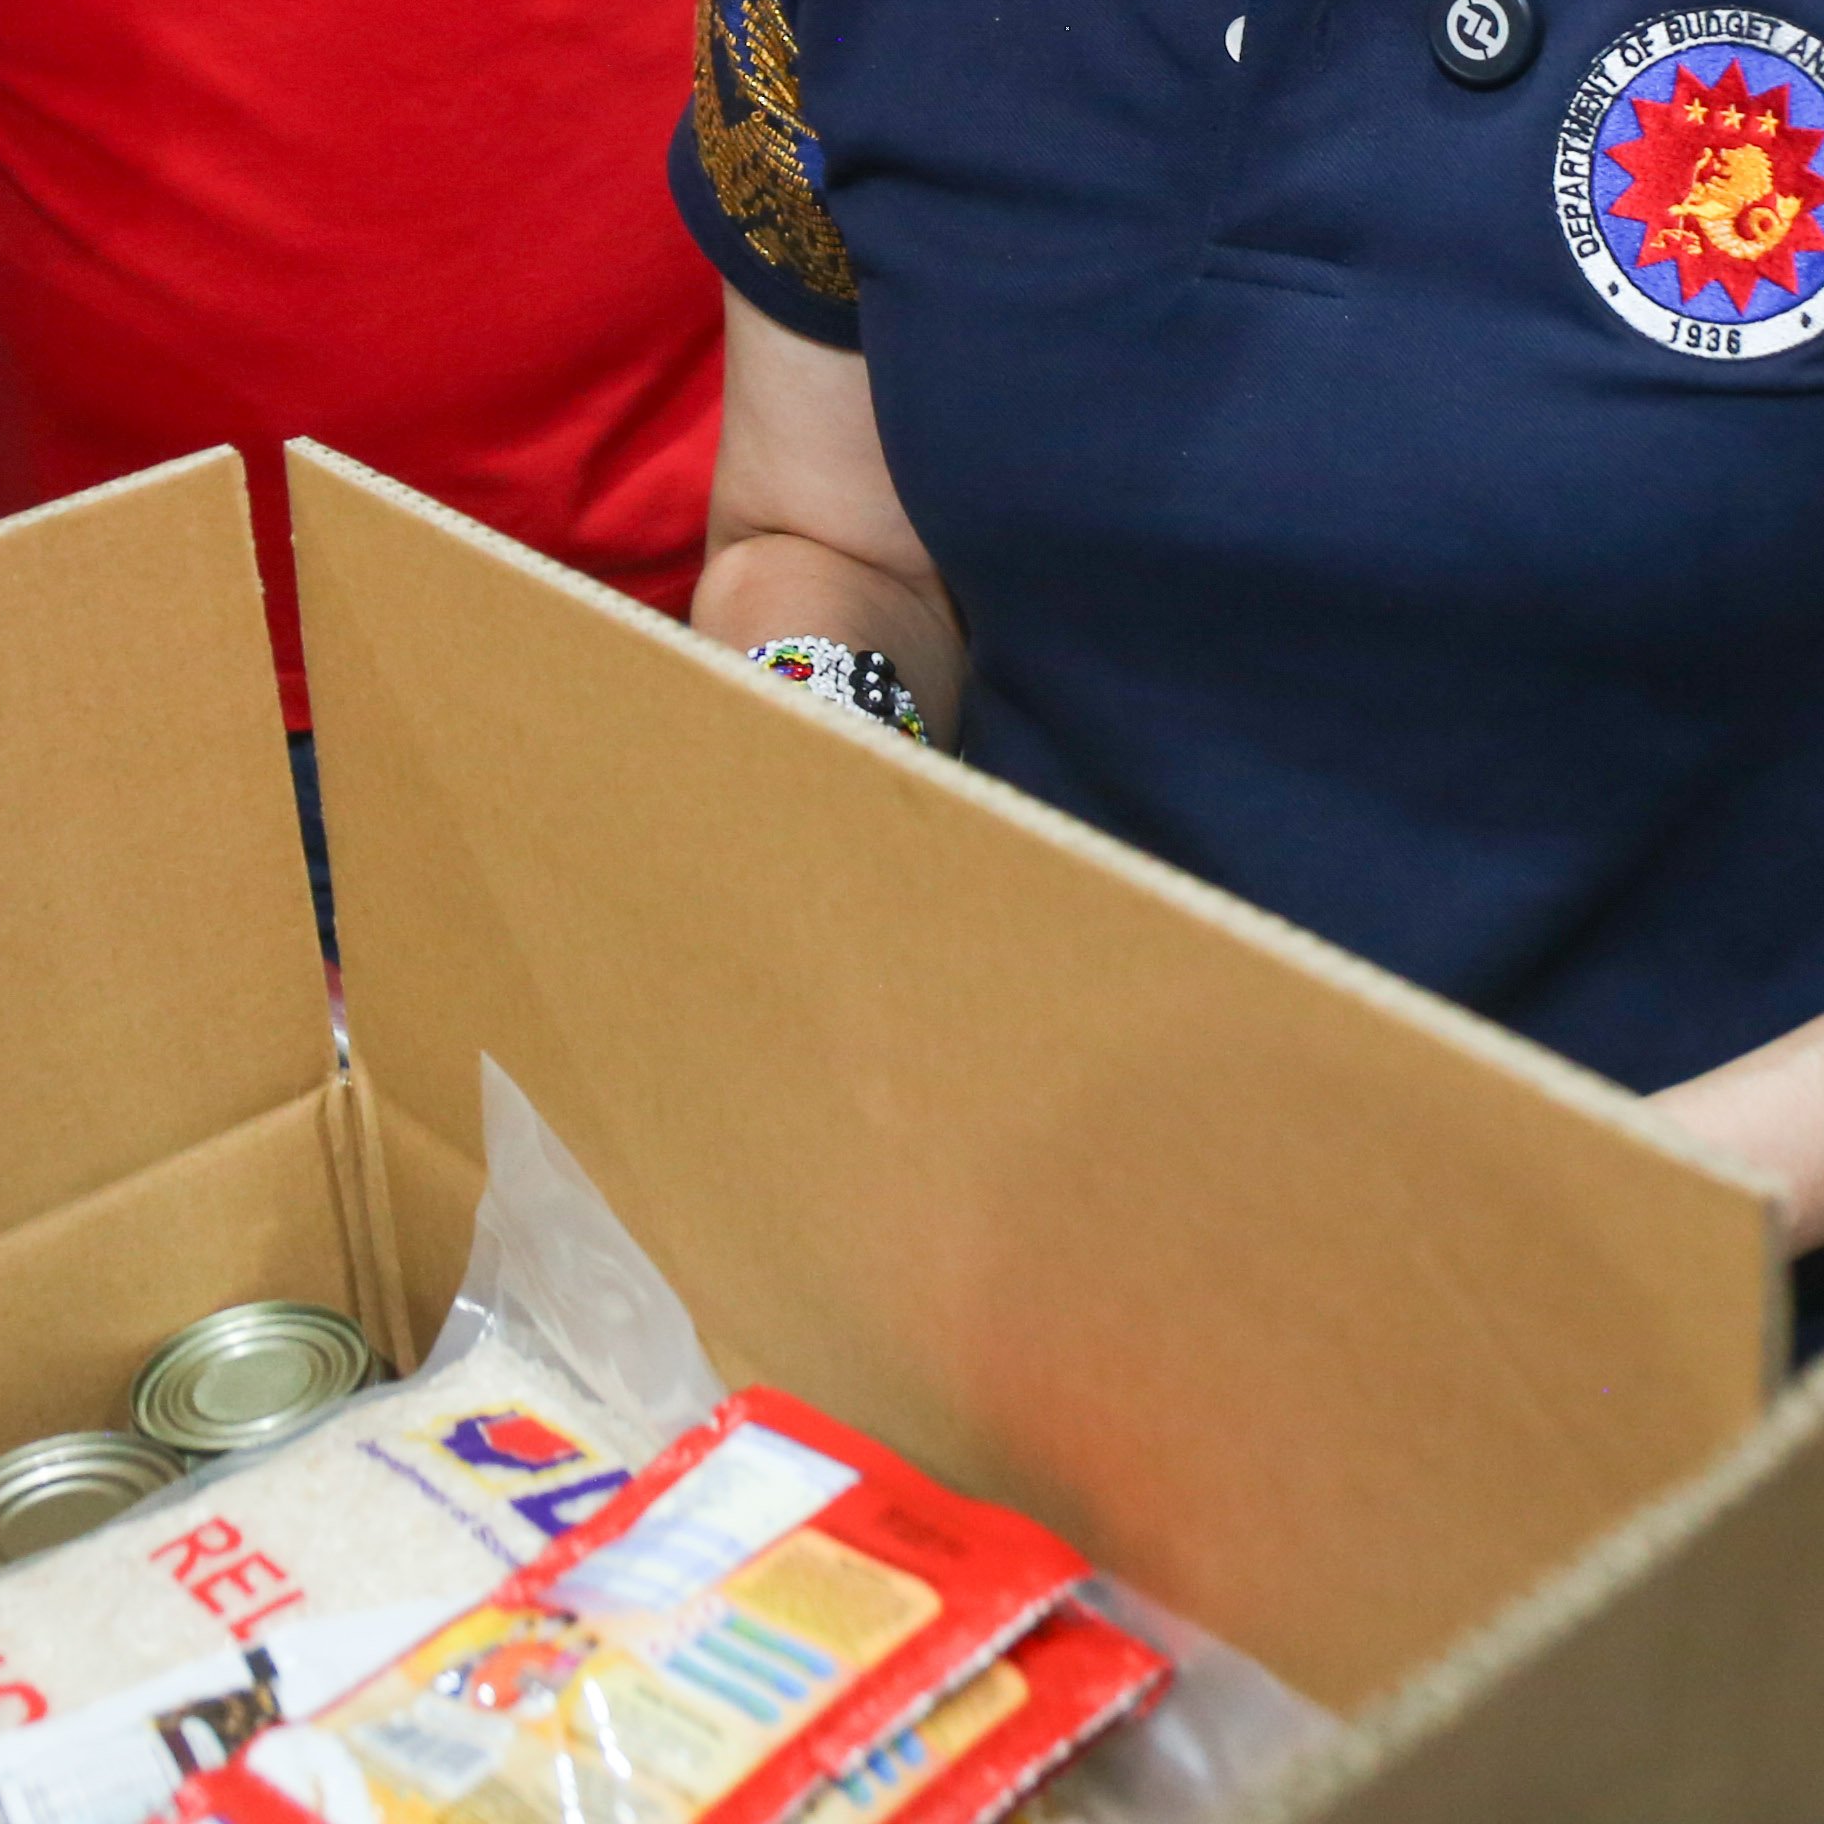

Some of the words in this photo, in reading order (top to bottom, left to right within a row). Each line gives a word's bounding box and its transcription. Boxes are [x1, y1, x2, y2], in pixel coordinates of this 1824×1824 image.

[1558, 62, 1619, 259] DEPARTMENT
[1620, 35, 1655, 68] OF
[1665, 10, 1781, 46] BUDGET
[1669, 319, 1742, 354] 1936
